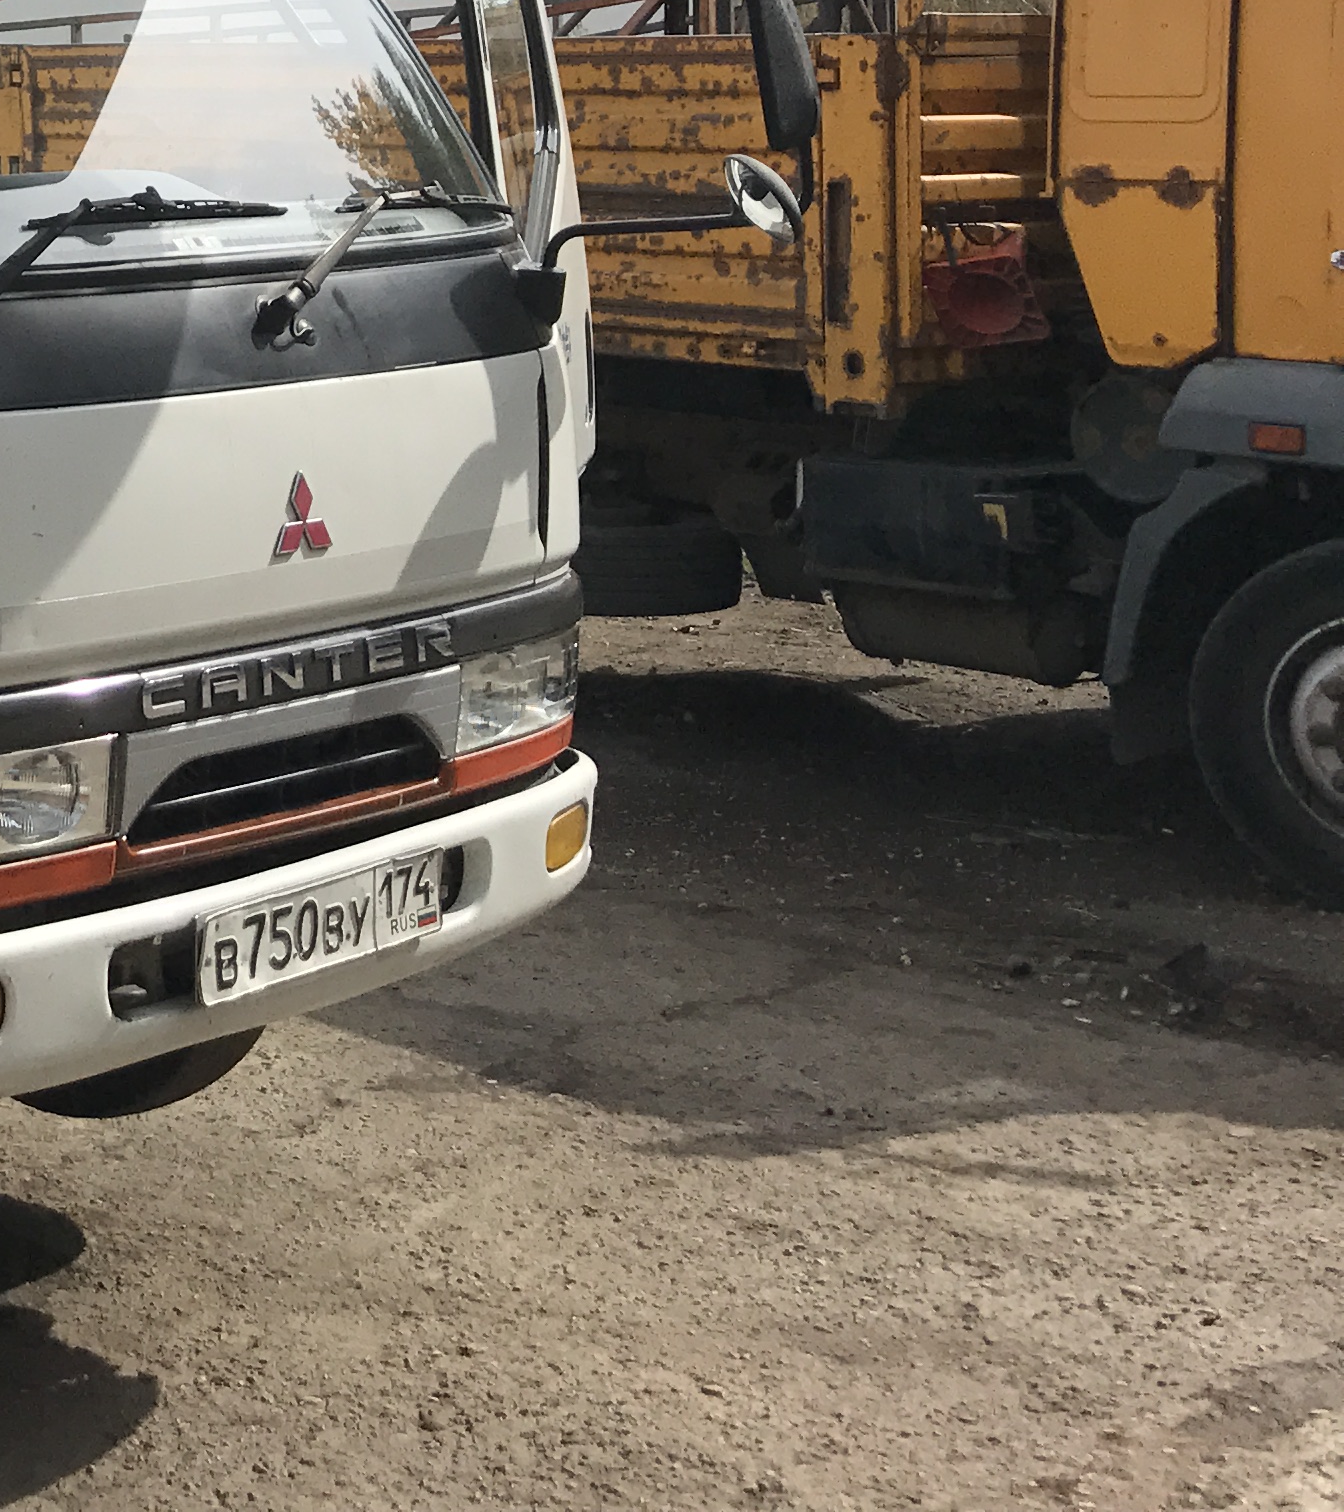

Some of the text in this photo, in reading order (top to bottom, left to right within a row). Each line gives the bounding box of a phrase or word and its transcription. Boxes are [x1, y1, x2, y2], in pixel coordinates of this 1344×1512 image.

[141, 621, 455, 720] CANTER
[378, 859, 435, 919] 174
[390, 912, 417, 936] RUS
